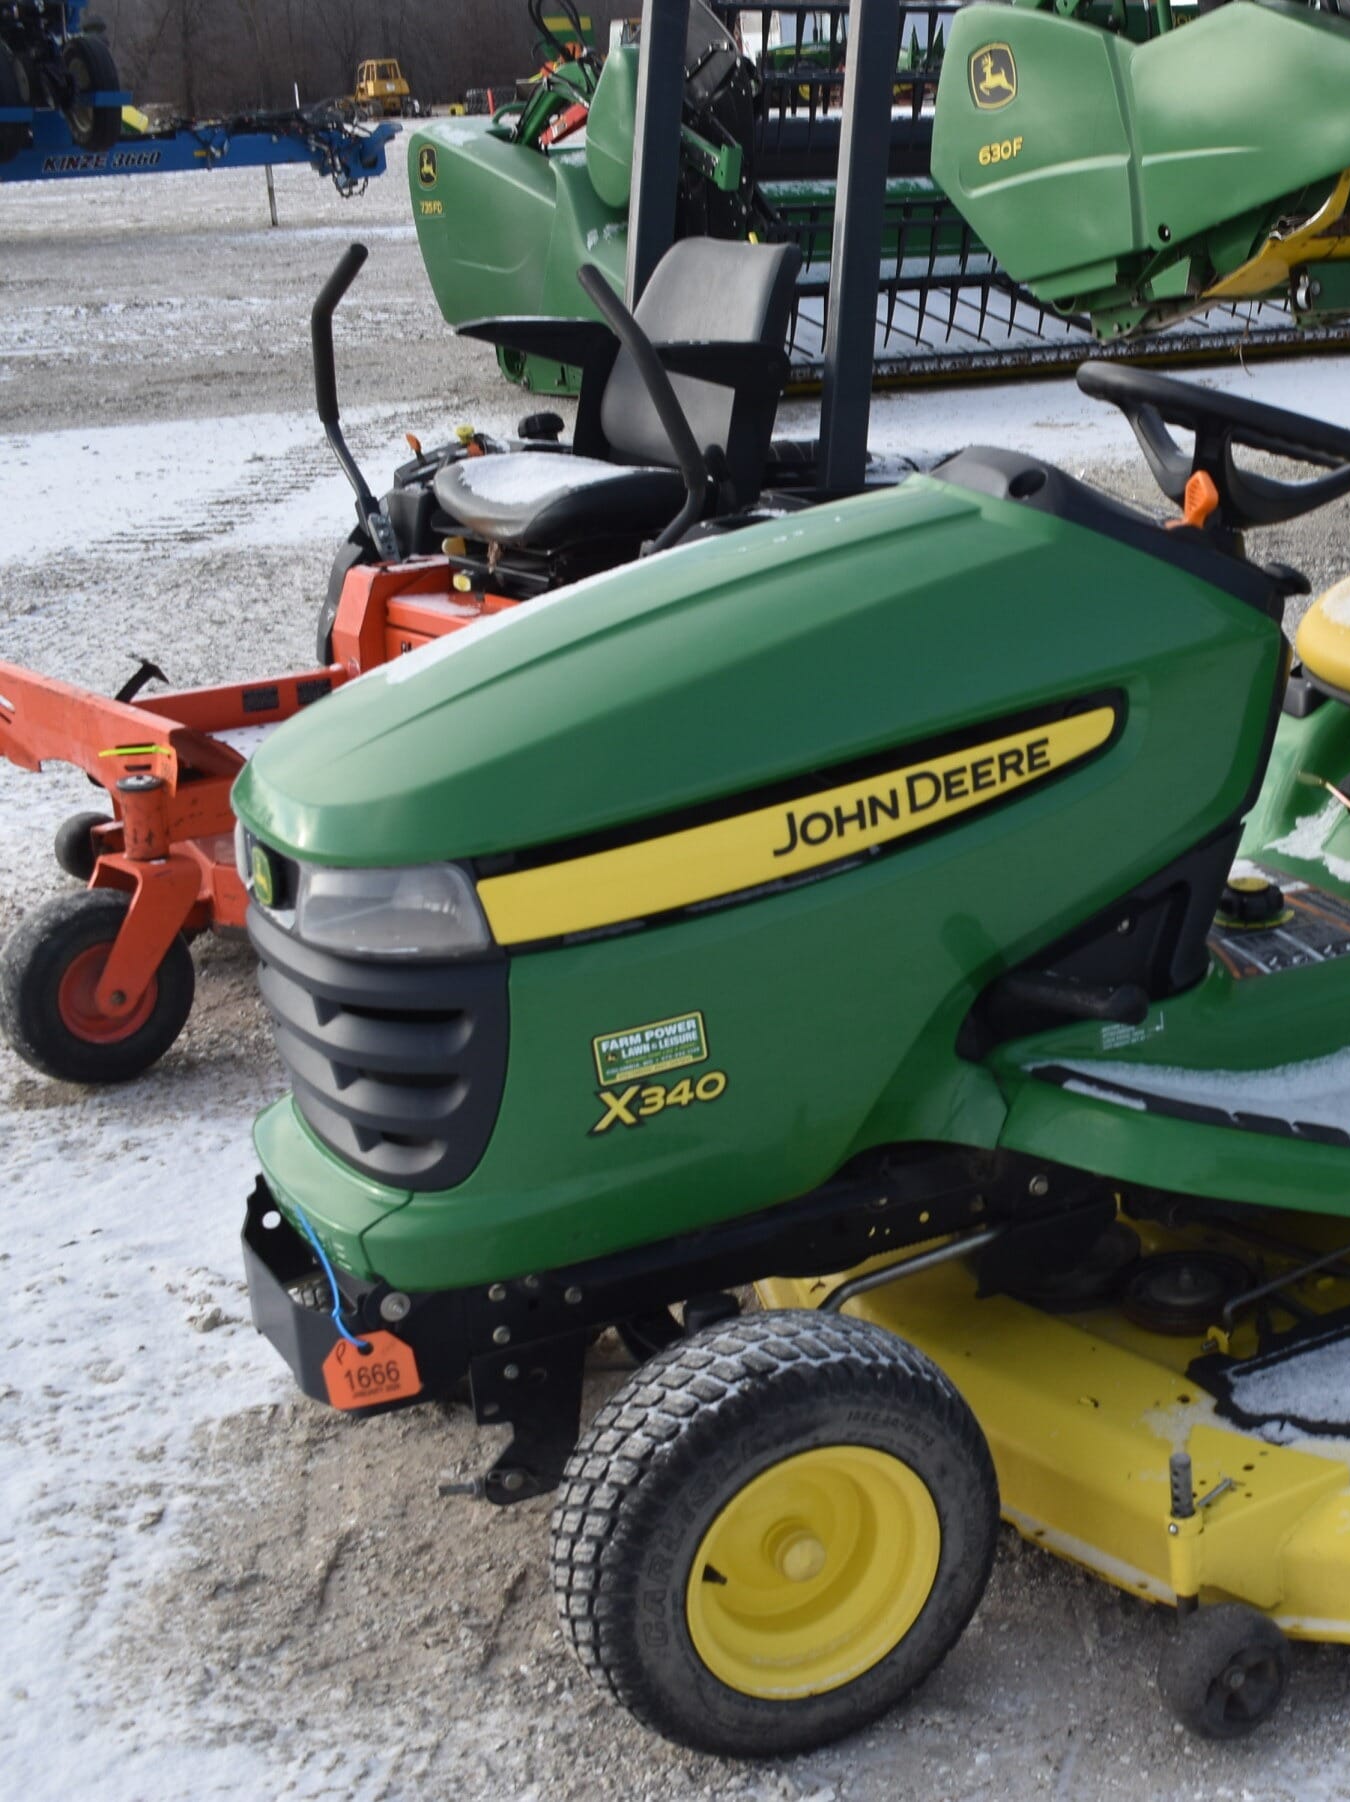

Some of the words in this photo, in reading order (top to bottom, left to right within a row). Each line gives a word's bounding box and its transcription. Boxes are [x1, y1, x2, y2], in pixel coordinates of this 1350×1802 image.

[42, 152, 107, 173] KINZE
[978, 135, 1023, 166] 630F
[773, 787, 901, 858] JOHN
[905, 737, 1052, 815] DEERE
[601, 1033, 642, 1053] FARM
[644, 1018, 697, 1042] POWER
[621, 1043, 650, 1059] LAWN
[659, 1030, 698, 1050] LEISURE
[590, 1070, 727, 1133] X340
[344, 1359, 401, 1393] 1666
